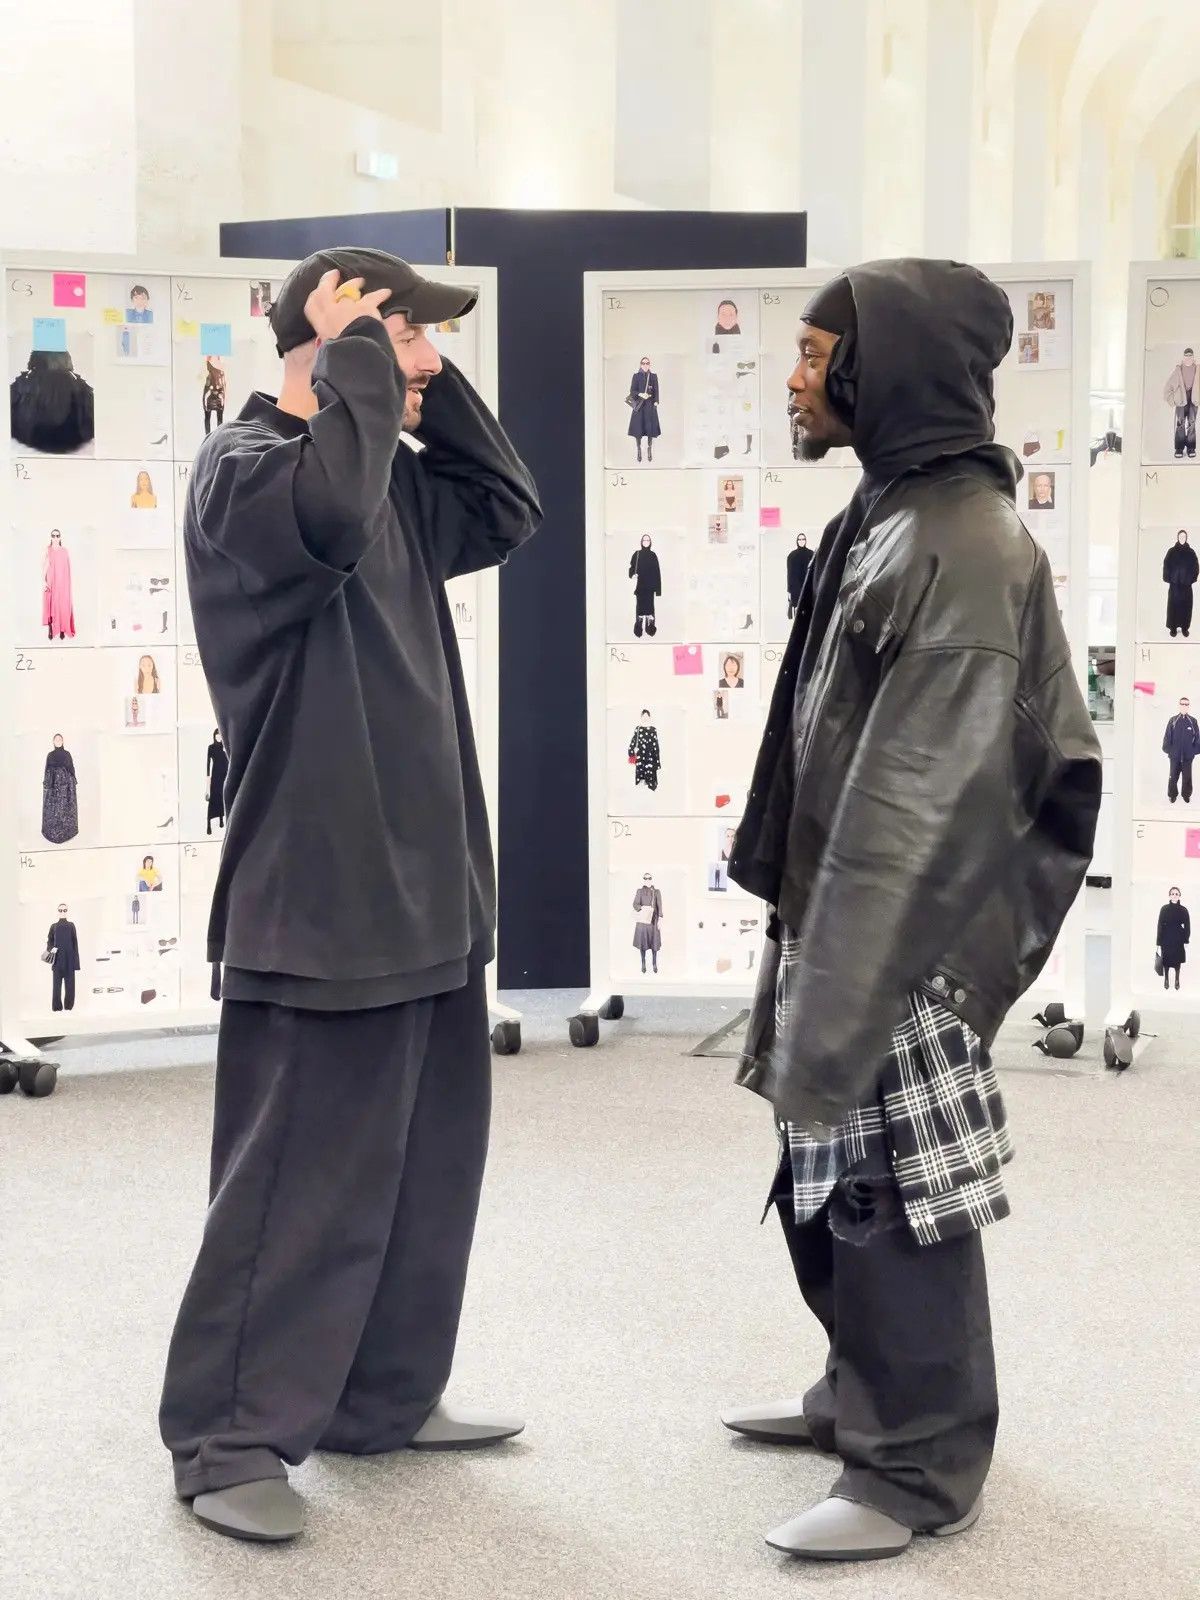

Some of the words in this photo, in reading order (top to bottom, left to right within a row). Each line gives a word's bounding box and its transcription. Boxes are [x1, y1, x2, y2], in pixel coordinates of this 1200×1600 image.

[11, 278, 33, 296] C3
[176, 282, 193, 301] Y2
[15, 463, 31, 480] P2
[1145, 472, 1158, 486] M
[15, 653, 35, 671] Z2
[610, 648, 630, 663] R2
[1141, 648, 1151, 662] H
[611, 821, 632, 838] D2
[183, 844, 197, 857] F2
[20, 856, 35, 868] H2
